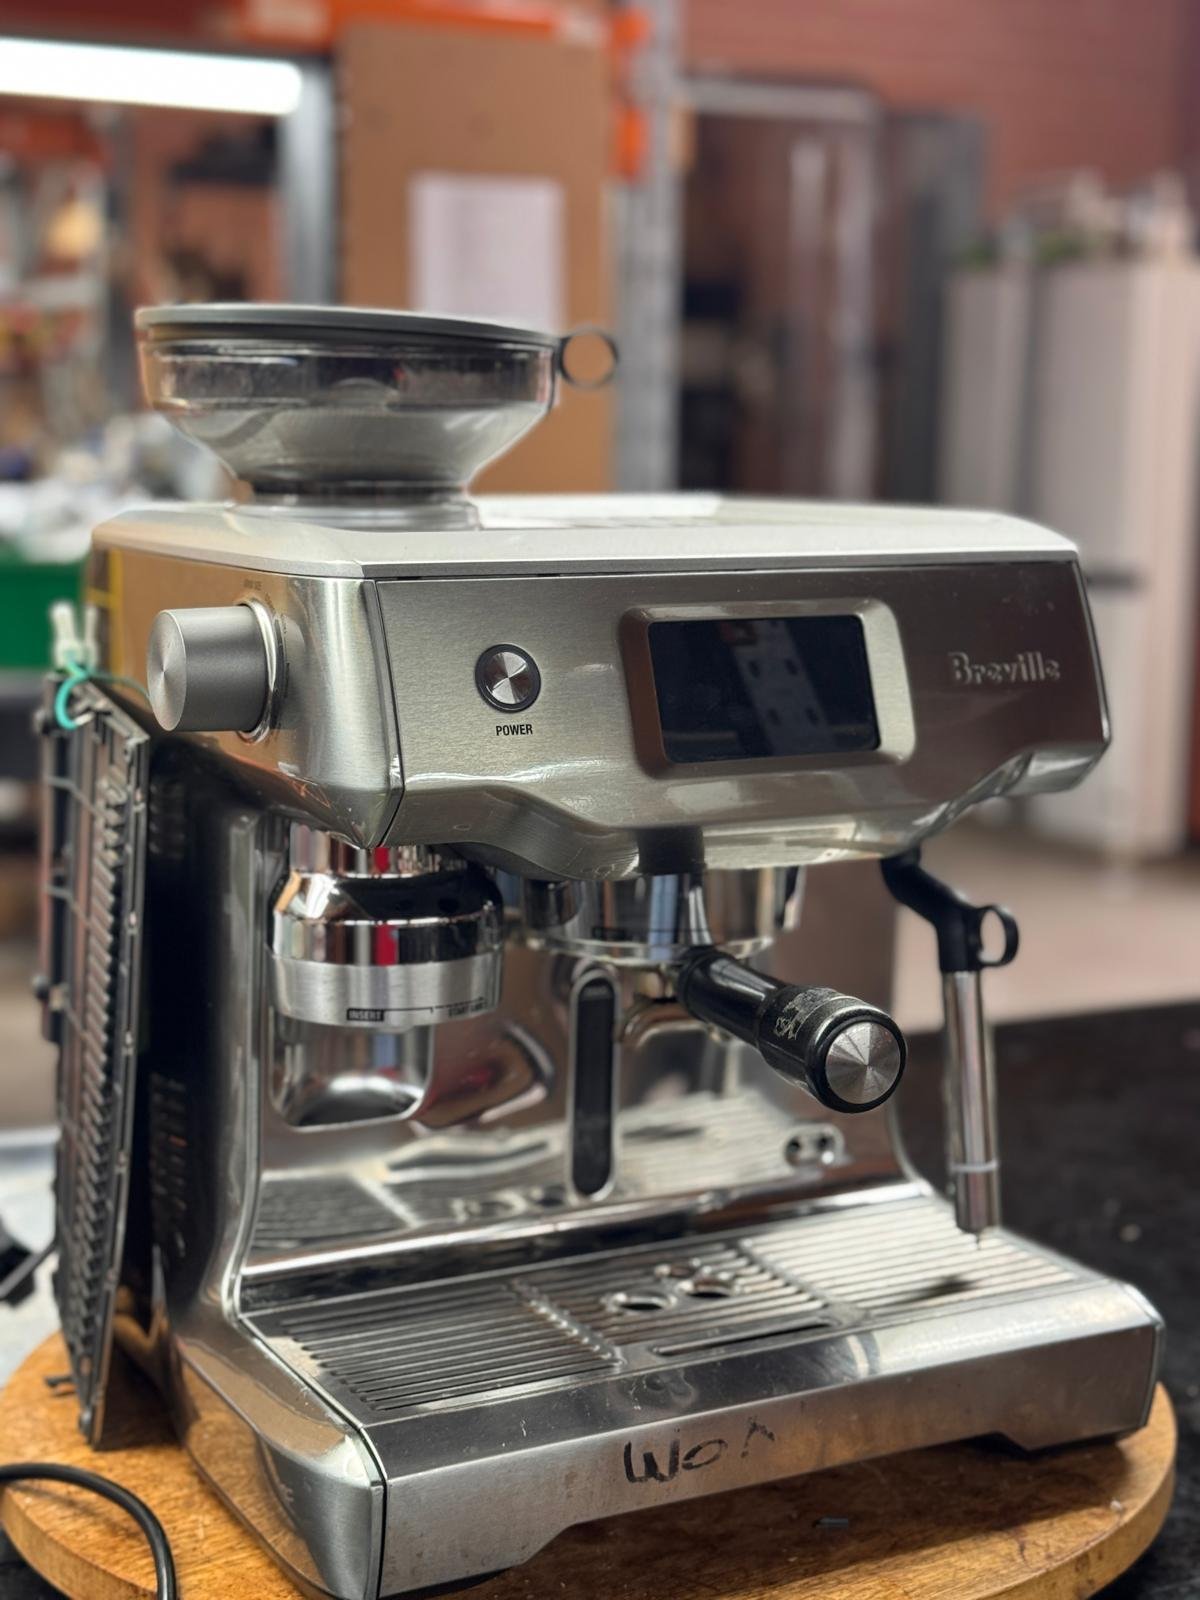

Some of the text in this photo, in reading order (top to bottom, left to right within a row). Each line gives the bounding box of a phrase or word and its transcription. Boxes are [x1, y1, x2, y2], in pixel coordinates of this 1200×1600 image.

[949, 651, 1061, 684] Breville
[495, 723, 533, 736] POWER
[348, 1009, 383, 1021] INSERT
